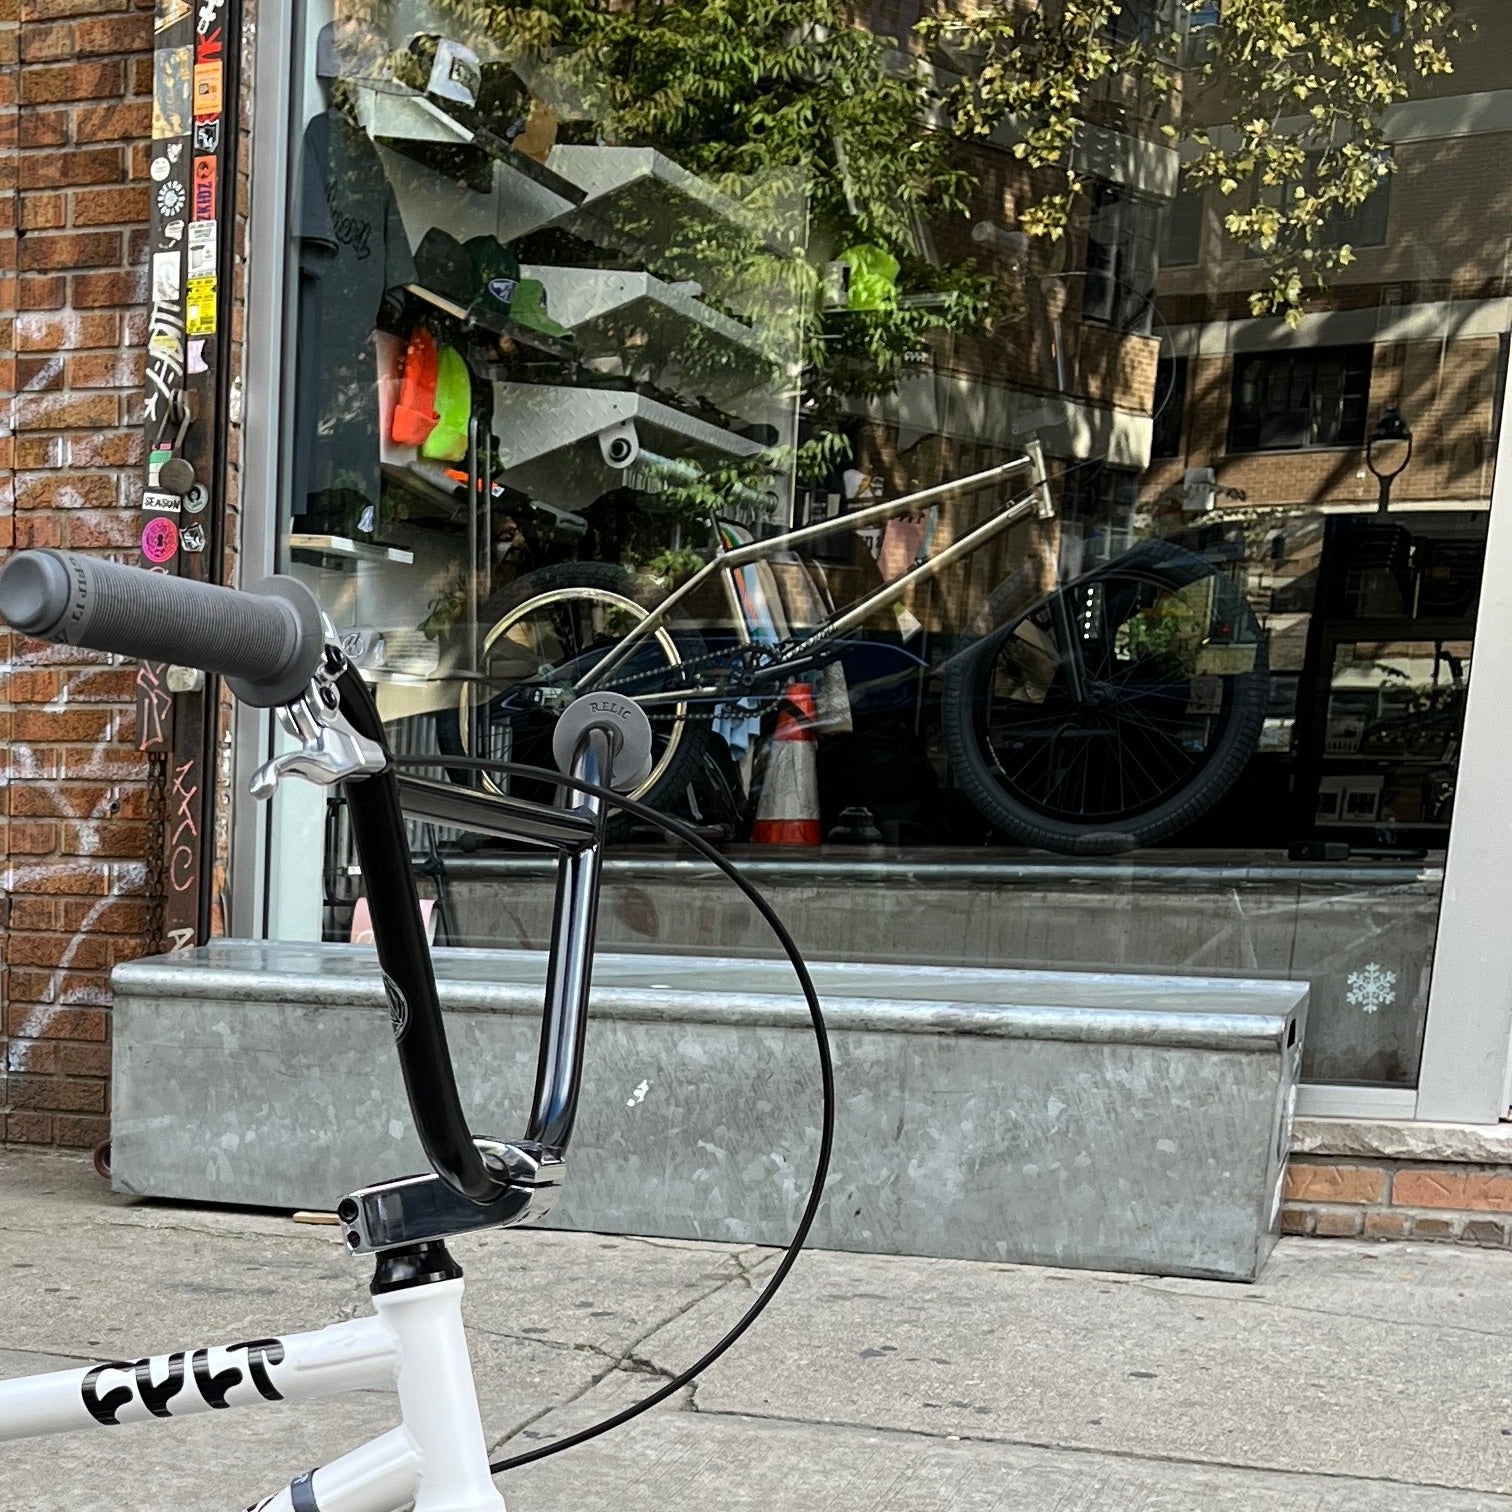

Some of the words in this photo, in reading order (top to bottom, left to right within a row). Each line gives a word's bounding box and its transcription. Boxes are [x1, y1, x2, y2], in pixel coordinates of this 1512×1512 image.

[144, 496, 180, 510] SEASON
[589, 702, 632, 720] RELIC
[81, 1338, 286, 1427] CULT
